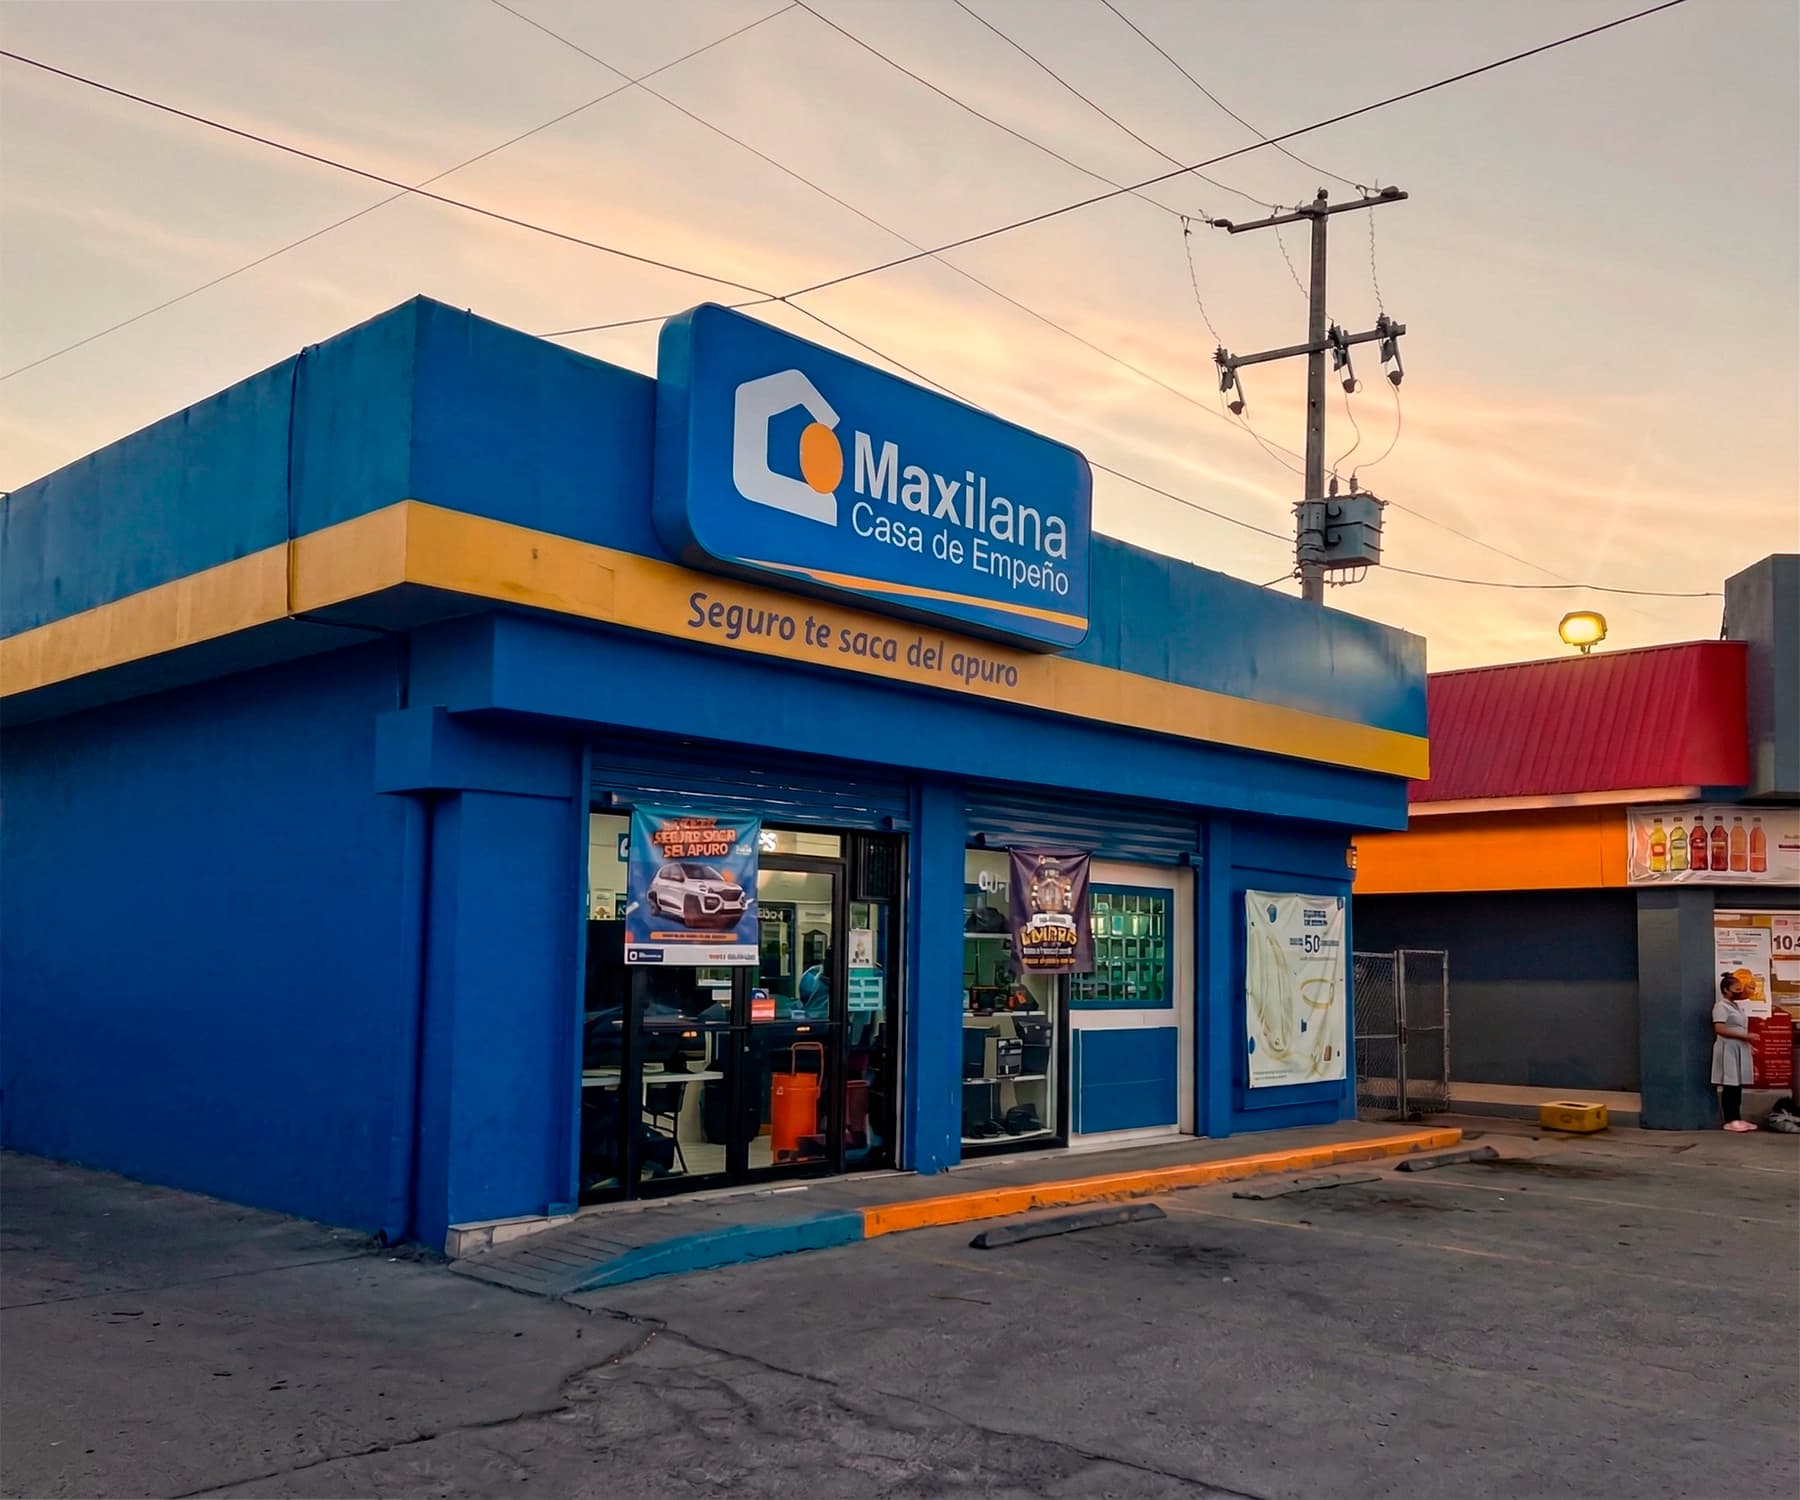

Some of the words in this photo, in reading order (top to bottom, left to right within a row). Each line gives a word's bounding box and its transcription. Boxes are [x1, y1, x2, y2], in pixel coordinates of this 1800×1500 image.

[854, 430, 1067, 559] Maxilana
[852, 501, 923, 552] Casa
[933, 529, 964, 564] de
[973, 539, 1069, 595] Empeño
[688, 593, 796, 640] Seguro
[804, 616, 830, 648] te
[839, 629, 897, 662] saca
[907, 637, 944, 671] del
[951, 652, 1018, 688] apuro
[687, 843, 729, 857] APURO
[1304, 934, 1321, 953] 50
